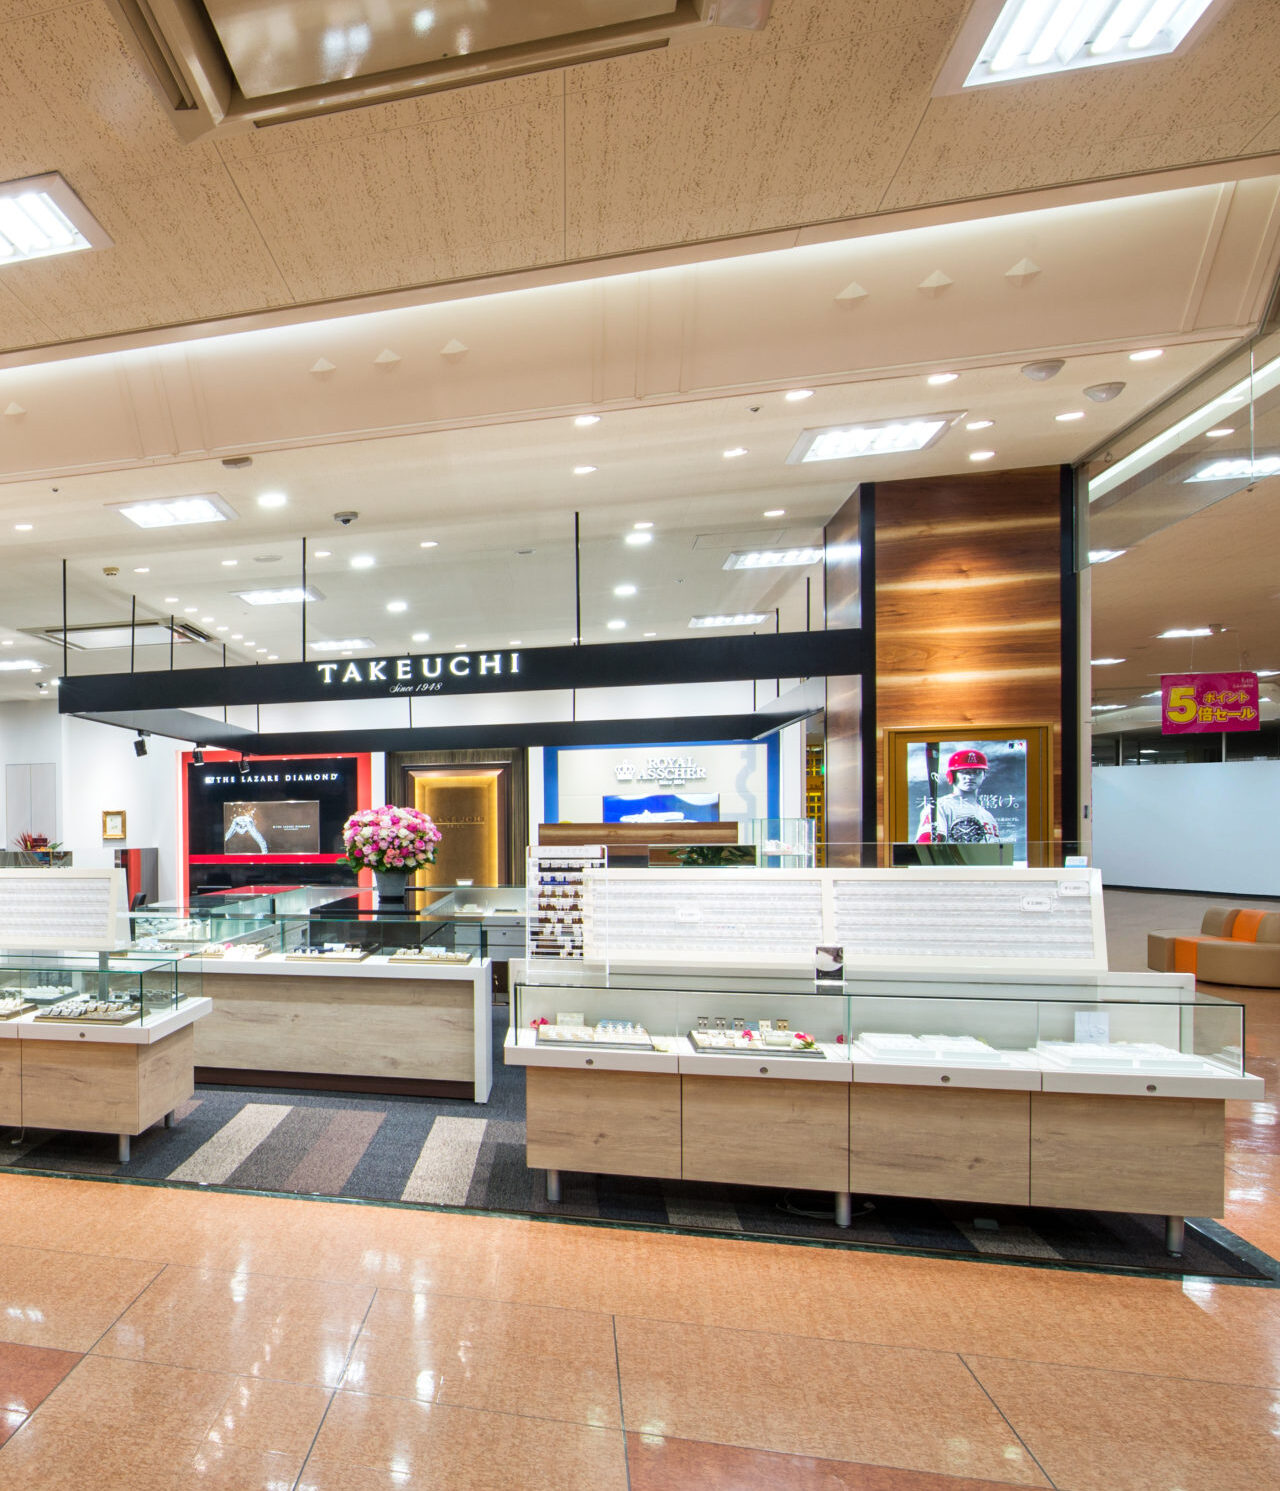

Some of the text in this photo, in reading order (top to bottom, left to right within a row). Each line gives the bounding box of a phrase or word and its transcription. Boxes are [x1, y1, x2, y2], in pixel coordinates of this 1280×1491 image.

[317, 652, 520, 684] TAKEUCHI
[389, 681, 444, 694] Since 1948
[1166, 686, 1198, 723] 5
[1203, 690, 1250, 705] ポイント
[1197, 705, 1258, 723] 倍セール
[648, 758, 697, 769] ROYAL
[216, 776, 235, 784] THE
[241, 775, 280, 783] LAZARE
[638, 767, 708, 780] ASSCHER
